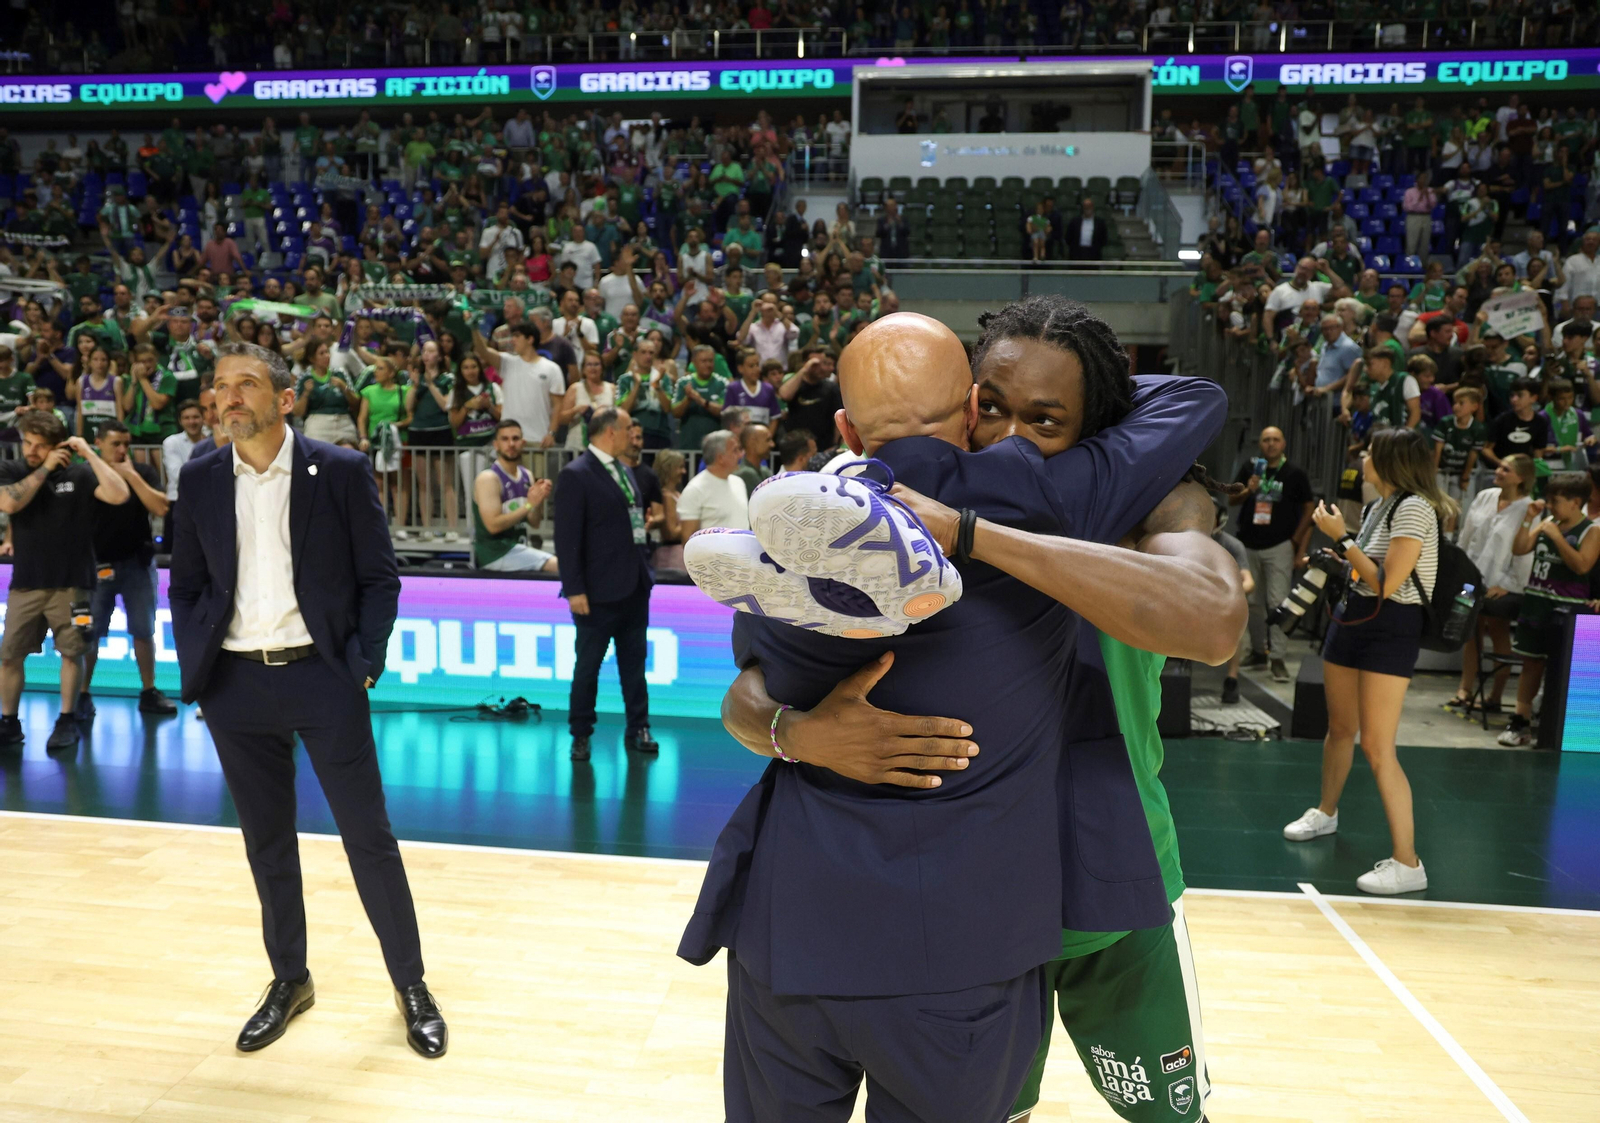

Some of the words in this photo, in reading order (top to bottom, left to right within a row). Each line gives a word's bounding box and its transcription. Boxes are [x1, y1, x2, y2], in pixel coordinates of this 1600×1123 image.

[254, 78, 377, 99] GRACIAS
[385, 67, 510, 97] AFICIÓN
[580, 70, 710, 92] GRACIAS
[720, 69, 834, 93] EQUIPO
[1280, 62, 1427, 85] GRACIAS
[1437, 60, 1568, 86] EQUIPO
[0, 84, 72, 103] CIAS
[80, 83, 183, 105] EQUIPO
[1533, 559, 1551, 581] 43
[1090, 1044, 1115, 1059] sabor
[1092, 1054, 1101, 1065] a
[1100, 1055, 1151, 1084] má
[1165, 1057, 1187, 1071] acb
[1096, 1065, 1155, 1105] laga
